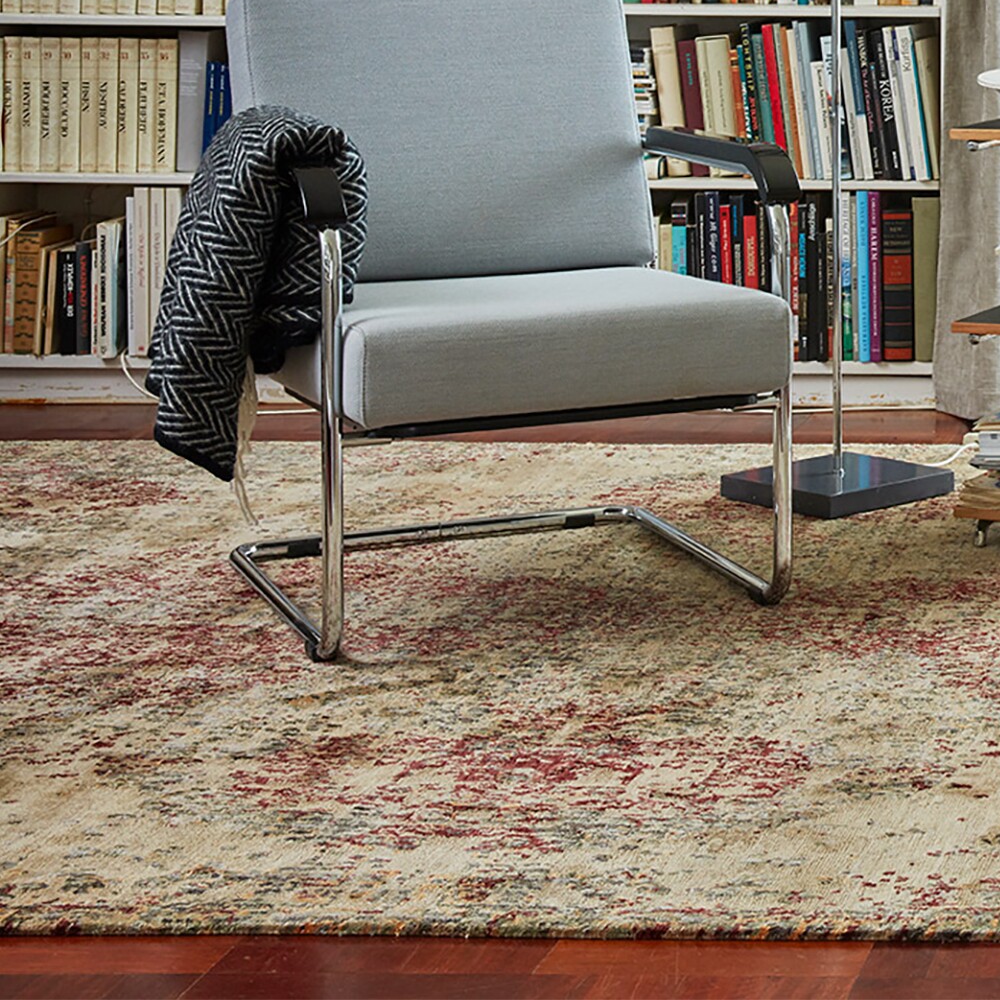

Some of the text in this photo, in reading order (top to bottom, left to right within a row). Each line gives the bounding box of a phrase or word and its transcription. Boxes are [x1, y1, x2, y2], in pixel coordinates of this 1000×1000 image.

[741, 26, 754, 91] LIGHTSHIP
[4, 81, 12, 125] DICKENS
[22, 82, 30, 127] FONTANE
[41, 81, 51, 139] HÖLDERLIN
[61, 82, 69, 138] BOCCACCIO
[81, 82, 89, 113] IBSEN
[99, 82, 107, 129] NESTROY
[138, 82, 147, 134] FLAUBERT
[879, 79, 893, 122] KOREA
[157, 108, 166, 164] HOFFMANN
[870, 227, 878, 261] HAREM
